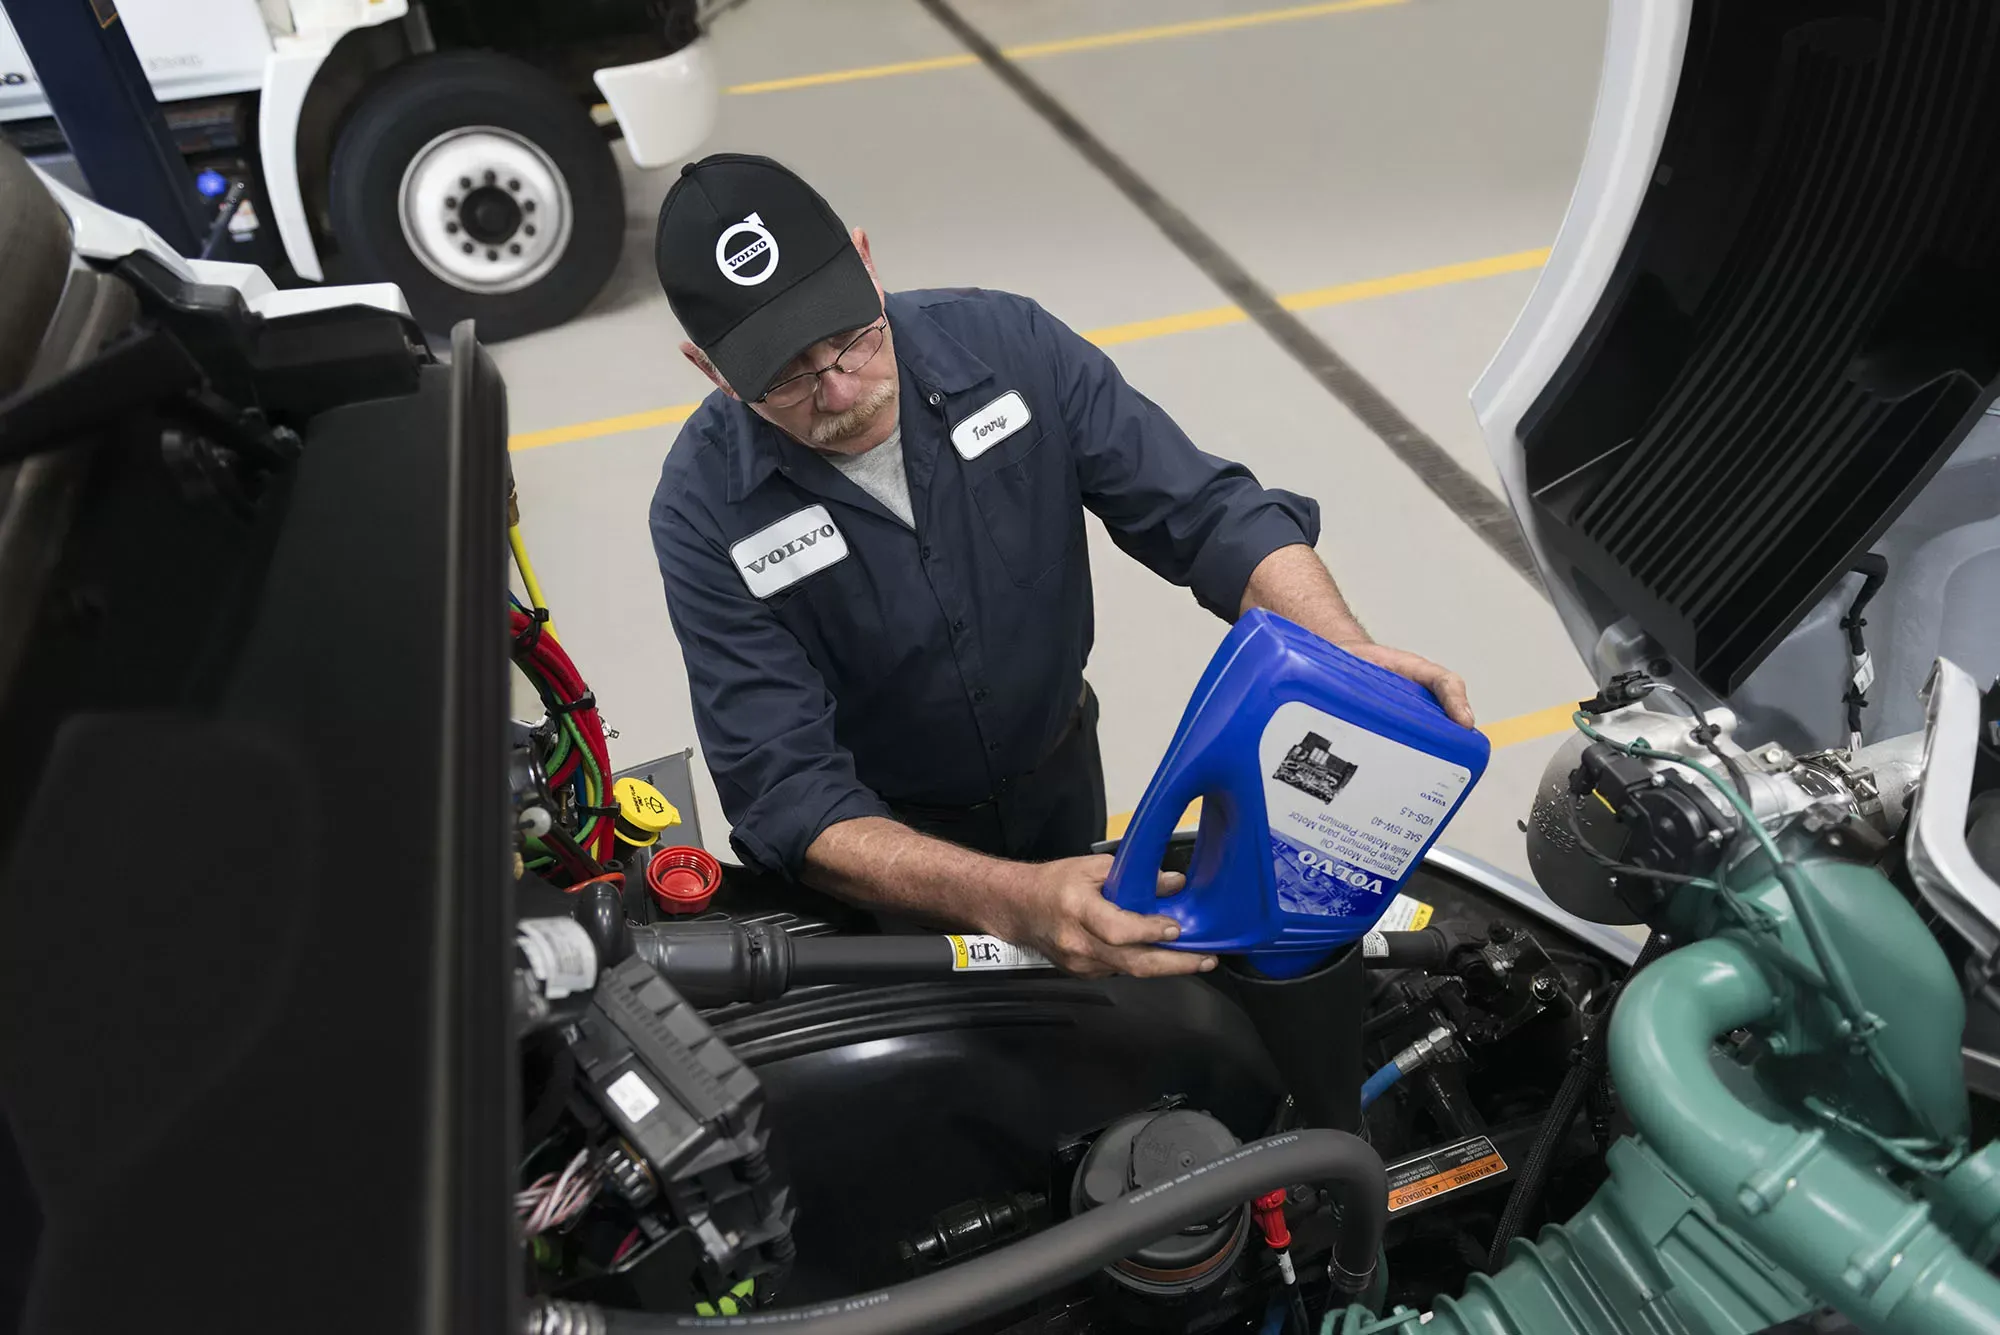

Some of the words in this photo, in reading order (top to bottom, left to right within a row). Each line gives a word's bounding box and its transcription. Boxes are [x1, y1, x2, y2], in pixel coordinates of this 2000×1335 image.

[728, 240, 767, 269] VOLVO
[972, 415, 1008, 441] Terry
[744, 523, 835, 575] VOLVO
[1419, 791, 1446, 807] VOLVO
[1288, 811, 1318, 830] Motor
[1317, 812, 1360, 836] Premium
[1369, 815, 1403, 835] 15W-40
[1398, 805, 1434, 827] VDS-4.5
[1317, 823, 1341, 838] para
[1358, 830, 1391, 850] Moteur
[1402, 829, 1423, 843] SAE
[1318, 837, 1335, 850] Oil
[1333, 843, 1363, 861] Motor
[1338, 833, 1380, 857] Premium
[1389, 843, 1412, 858] Huile
[1361, 855, 1399, 875] Premium
[1378, 850, 1405, 866] Aceite
[1297, 850, 1382, 895] VOLVO
[1452, 1165, 1491, 1185] WARNING
[1395, 1186, 1433, 1205] CUIDADO
